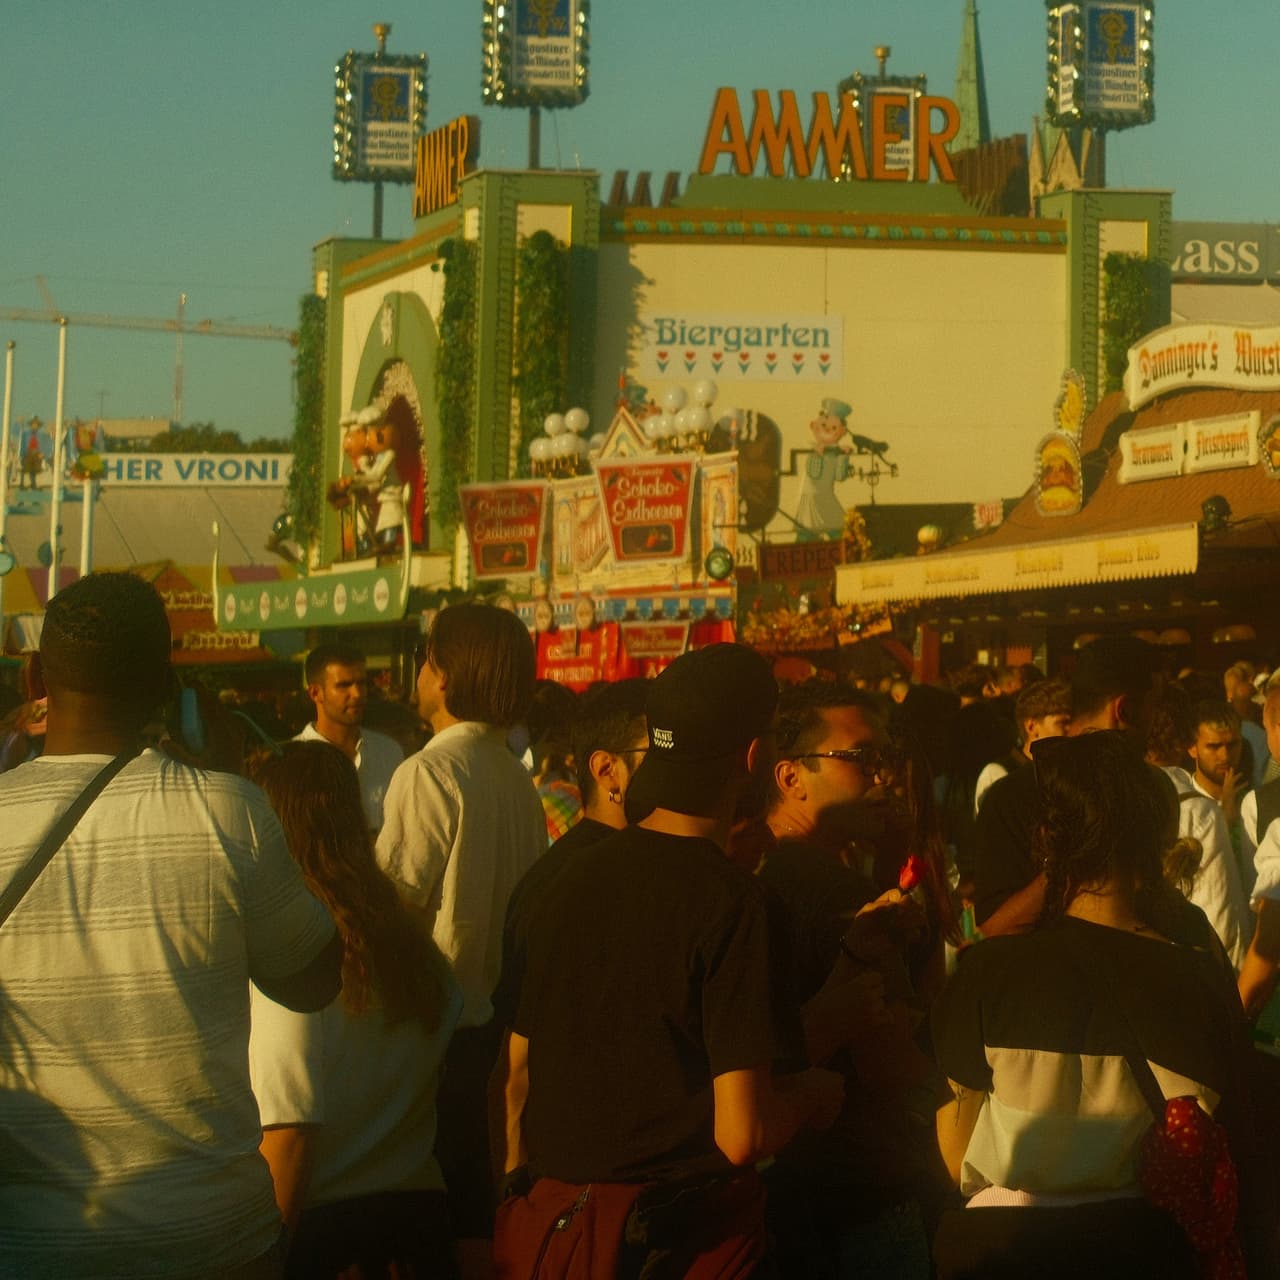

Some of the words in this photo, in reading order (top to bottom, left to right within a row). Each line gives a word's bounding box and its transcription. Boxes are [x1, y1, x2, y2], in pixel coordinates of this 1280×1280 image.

[698, 86, 961, 182] AMMER
[412, 112, 469, 219] AMMER
[653, 318, 831, 352] Biergarten
[103, 458, 164, 481] HER
[174, 459, 279, 481] VRONI
[617, 476, 677, 498] Schoko-
[612, 498, 683, 524] Erdbeeren
